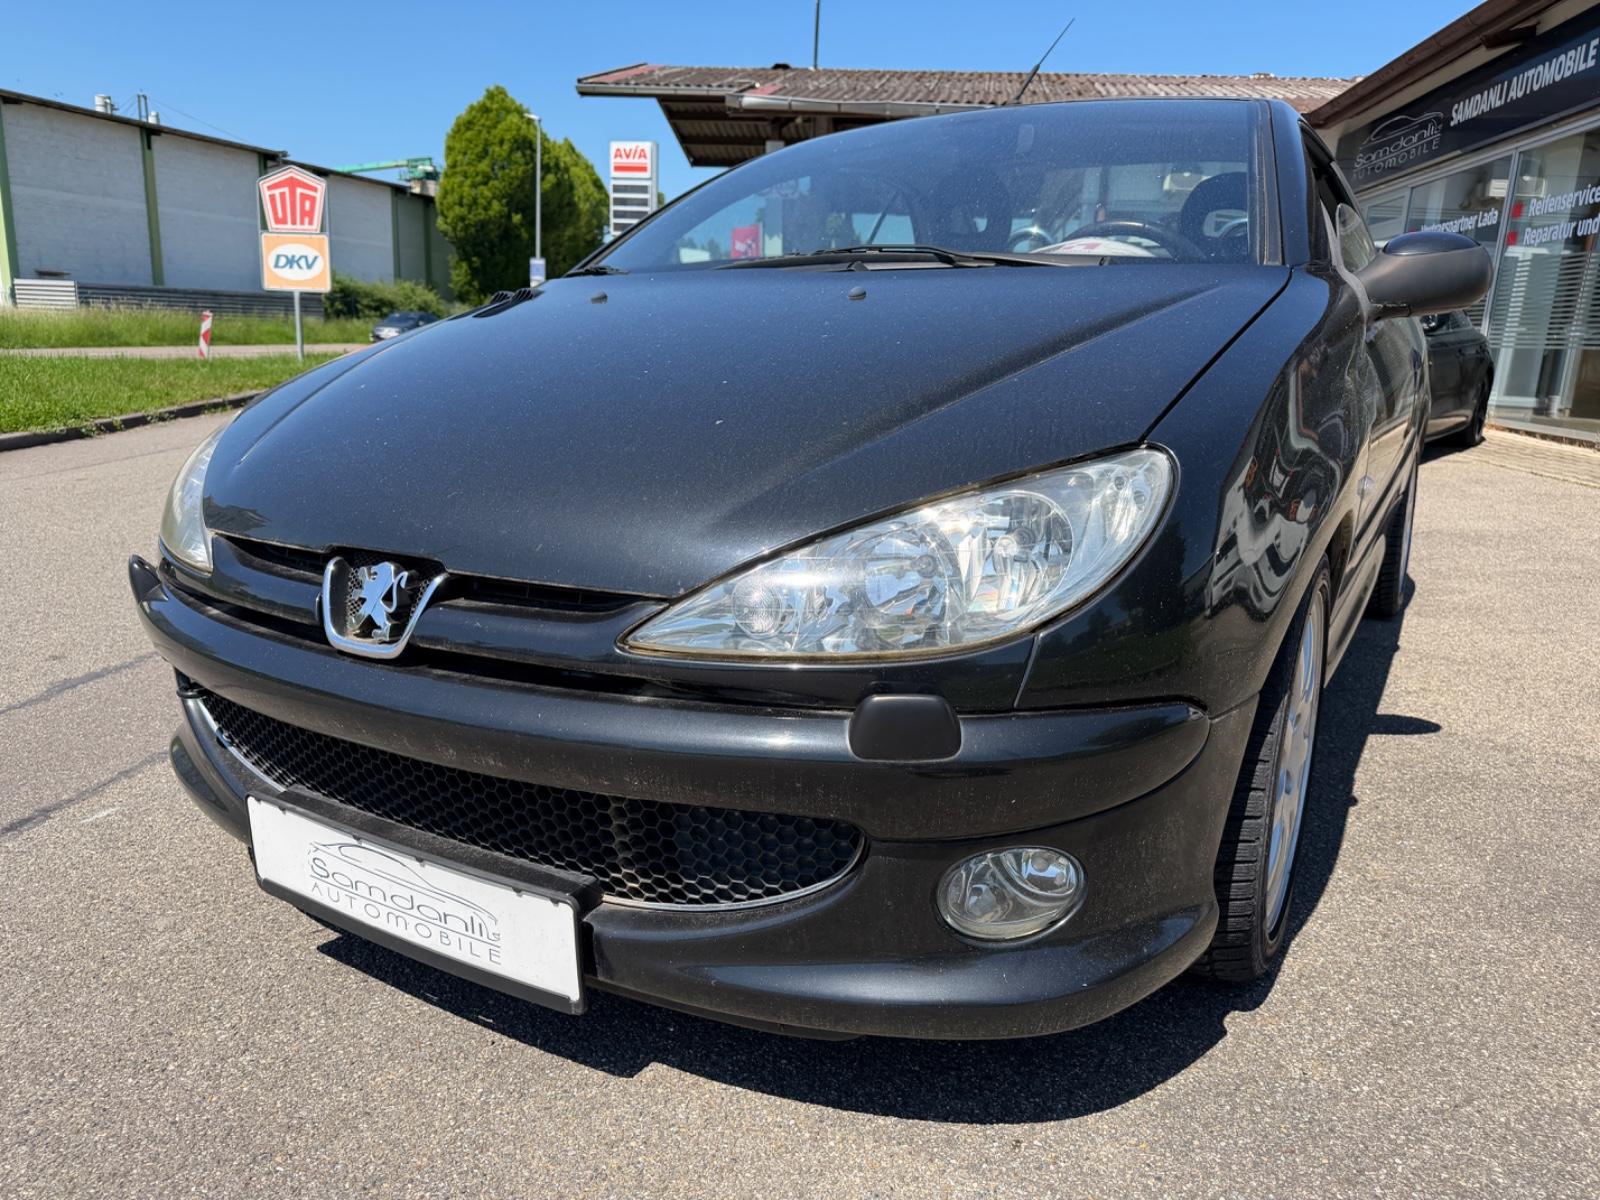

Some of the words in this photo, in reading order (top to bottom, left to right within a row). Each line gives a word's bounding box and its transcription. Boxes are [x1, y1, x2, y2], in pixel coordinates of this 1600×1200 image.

[1450, 81, 1508, 127] SAMDANLI
[1507, 37, 1599, 103] AUTOMOBILE
[613, 146, 648, 160] AVIA
[1354, 121, 1436, 168] Samdanli
[266, 175, 319, 226] UTA
[1478, 207, 1499, 228] Lada
[1528, 183, 1600, 217] Reifenservice
[1523, 220, 1577, 247] Reparatur
[1577, 213, 1600, 237] und
[274, 254, 319, 270] DKV
[310, 856, 487, 939] Samdanli
[311, 882, 502, 966] AUTOMOBILE
